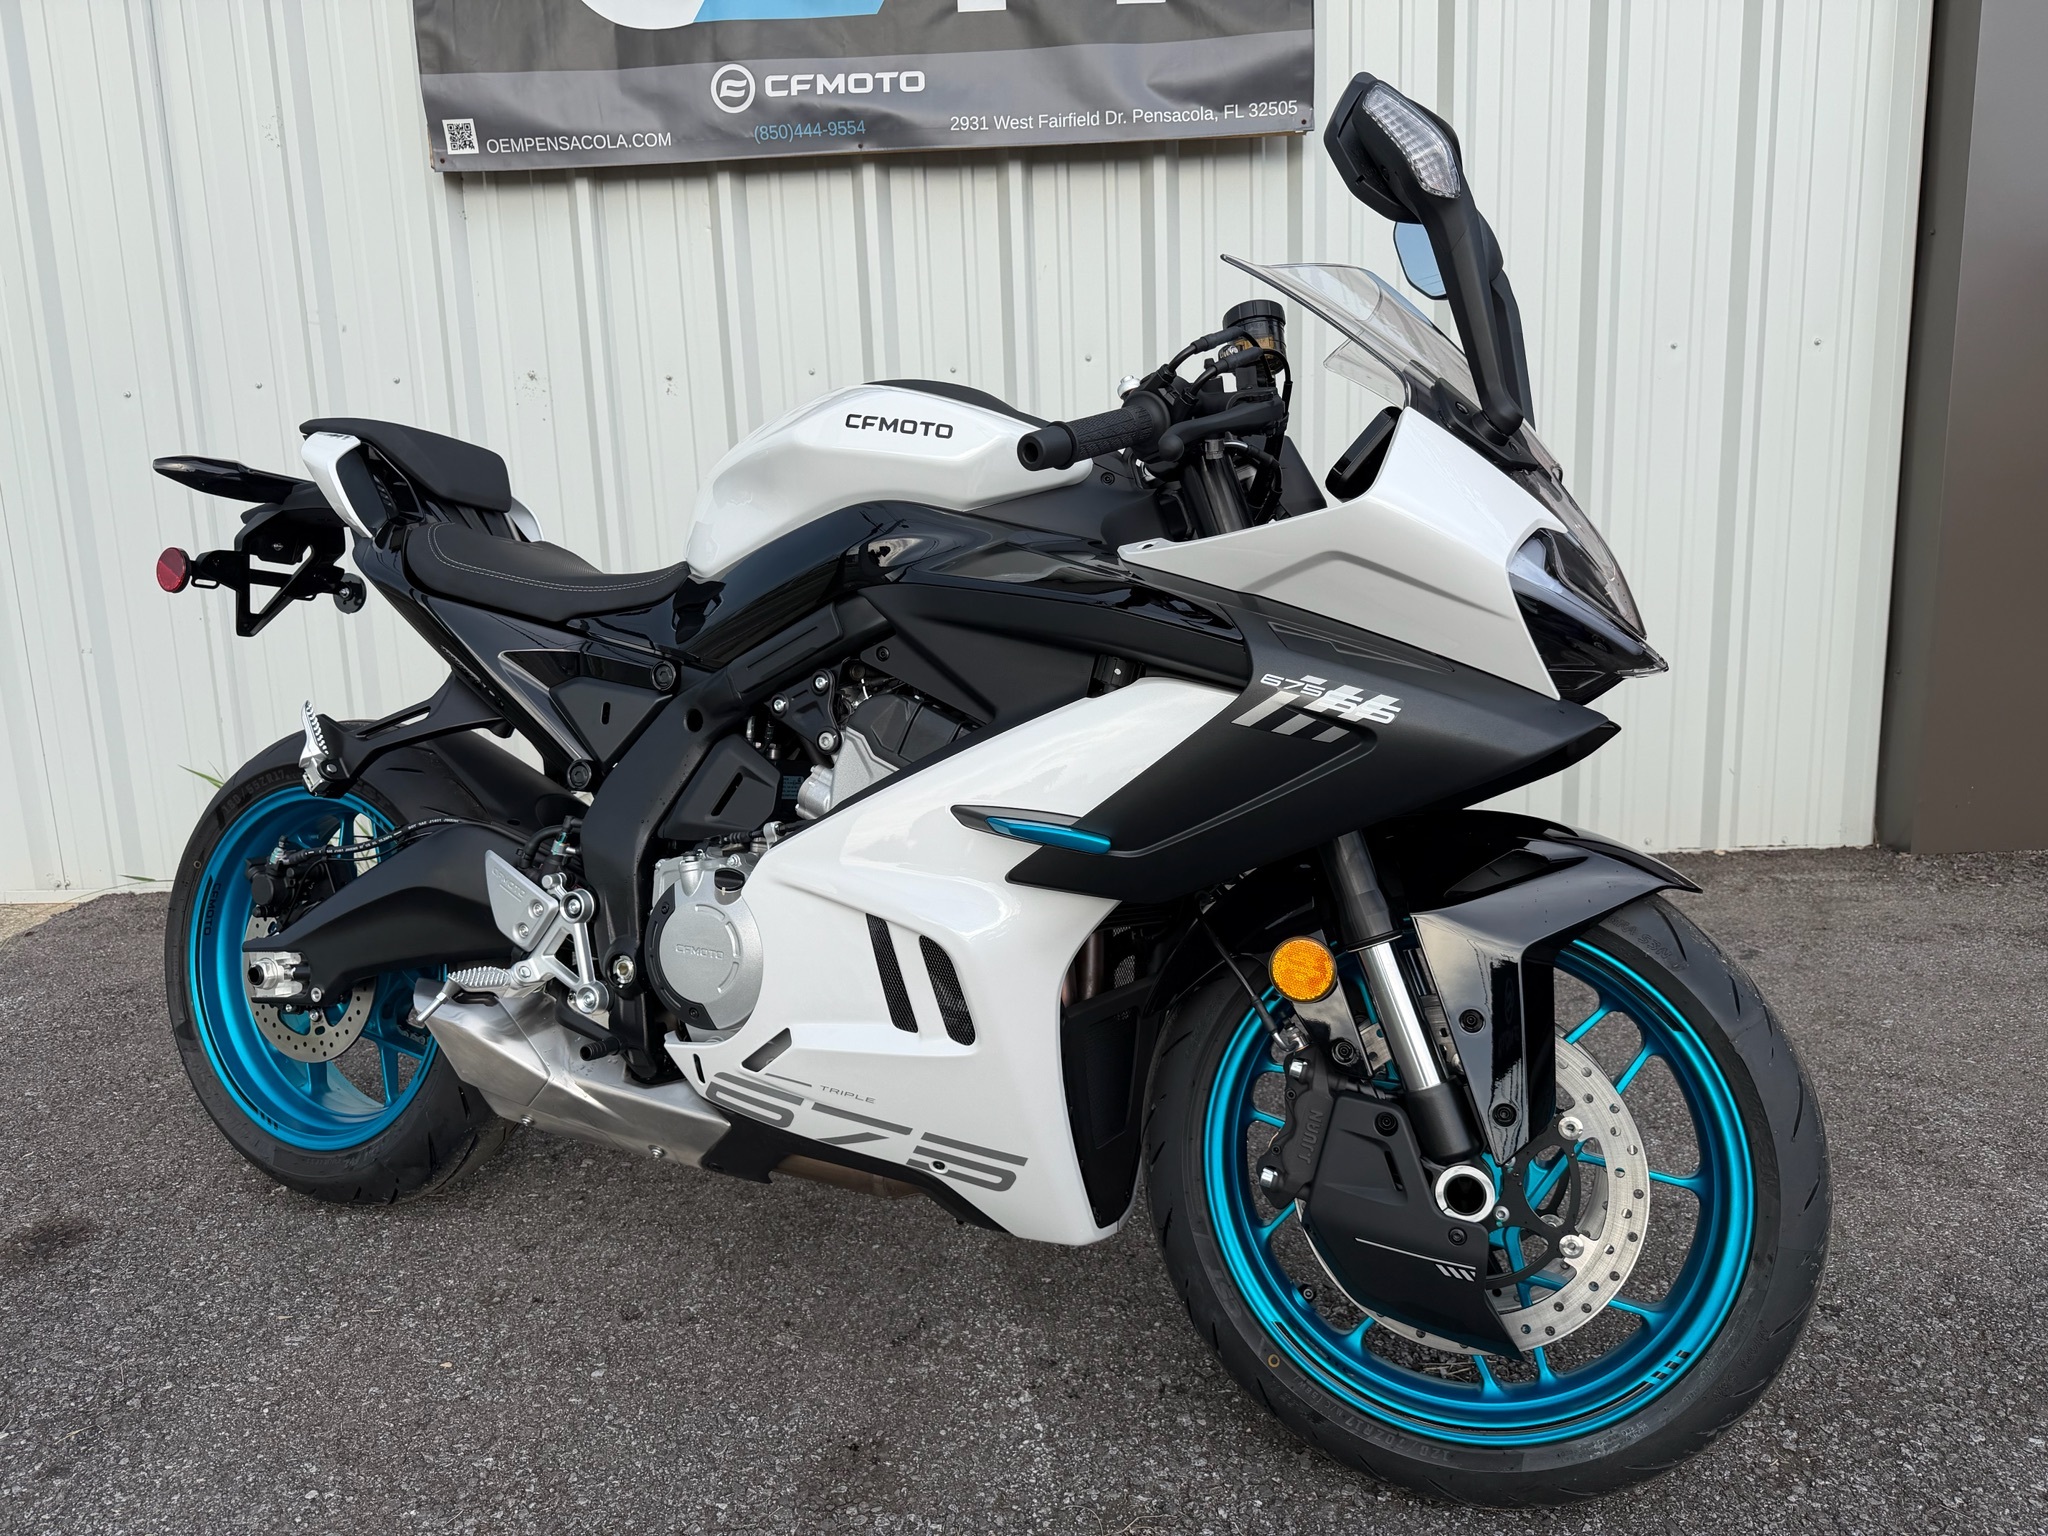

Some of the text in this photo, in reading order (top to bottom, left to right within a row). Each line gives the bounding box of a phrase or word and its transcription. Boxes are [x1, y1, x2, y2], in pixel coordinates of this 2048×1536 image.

[764, 70, 926, 98] CFMOTO
[949, 100, 1298, 132] 2931 West Fairfield Dr. Pensacola, FL 32505
[485, 131, 672, 154] OEMPENSACOLA.COM
[753, 118, 867, 143] (850)444-9554
[845, 413, 954, 439] CFMOTO
[1259, 673, 1326, 698] 675
[203, 882, 222, 936] CFMOTO
[675, 943, 725, 960] CFMOTO
[819, 1084, 877, 1104] TRIPLE
[705, 1071, 1029, 1192] 675
[1297, 1109, 1325, 1165] J.JUAN
[1344, 1415, 1450, 1462] 120/70ZR17
